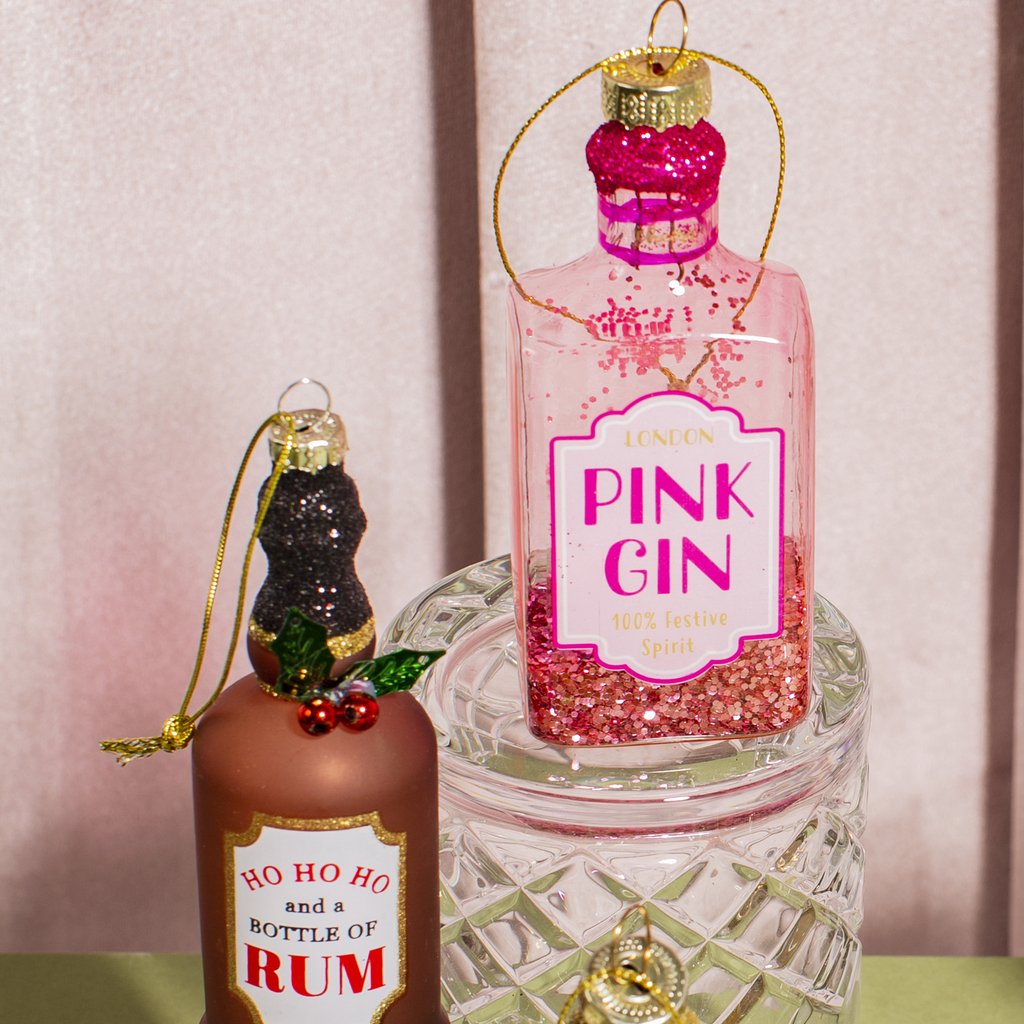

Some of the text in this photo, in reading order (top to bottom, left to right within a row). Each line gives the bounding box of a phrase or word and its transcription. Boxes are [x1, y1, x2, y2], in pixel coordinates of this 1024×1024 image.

[625, 427, 714, 448] LONDON
[584, 461, 754, 526] PINK
[604, 533, 731, 596] GIN
[612, 610, 729, 631] 100% Festive
[641, 638, 695, 658] Spirit
[240, 863, 391, 894] HO HO HO
[285, 898, 345, 914] and a
[249, 917, 378, 943] BOTTLE OF
[244, 942, 386, 997] RUM
